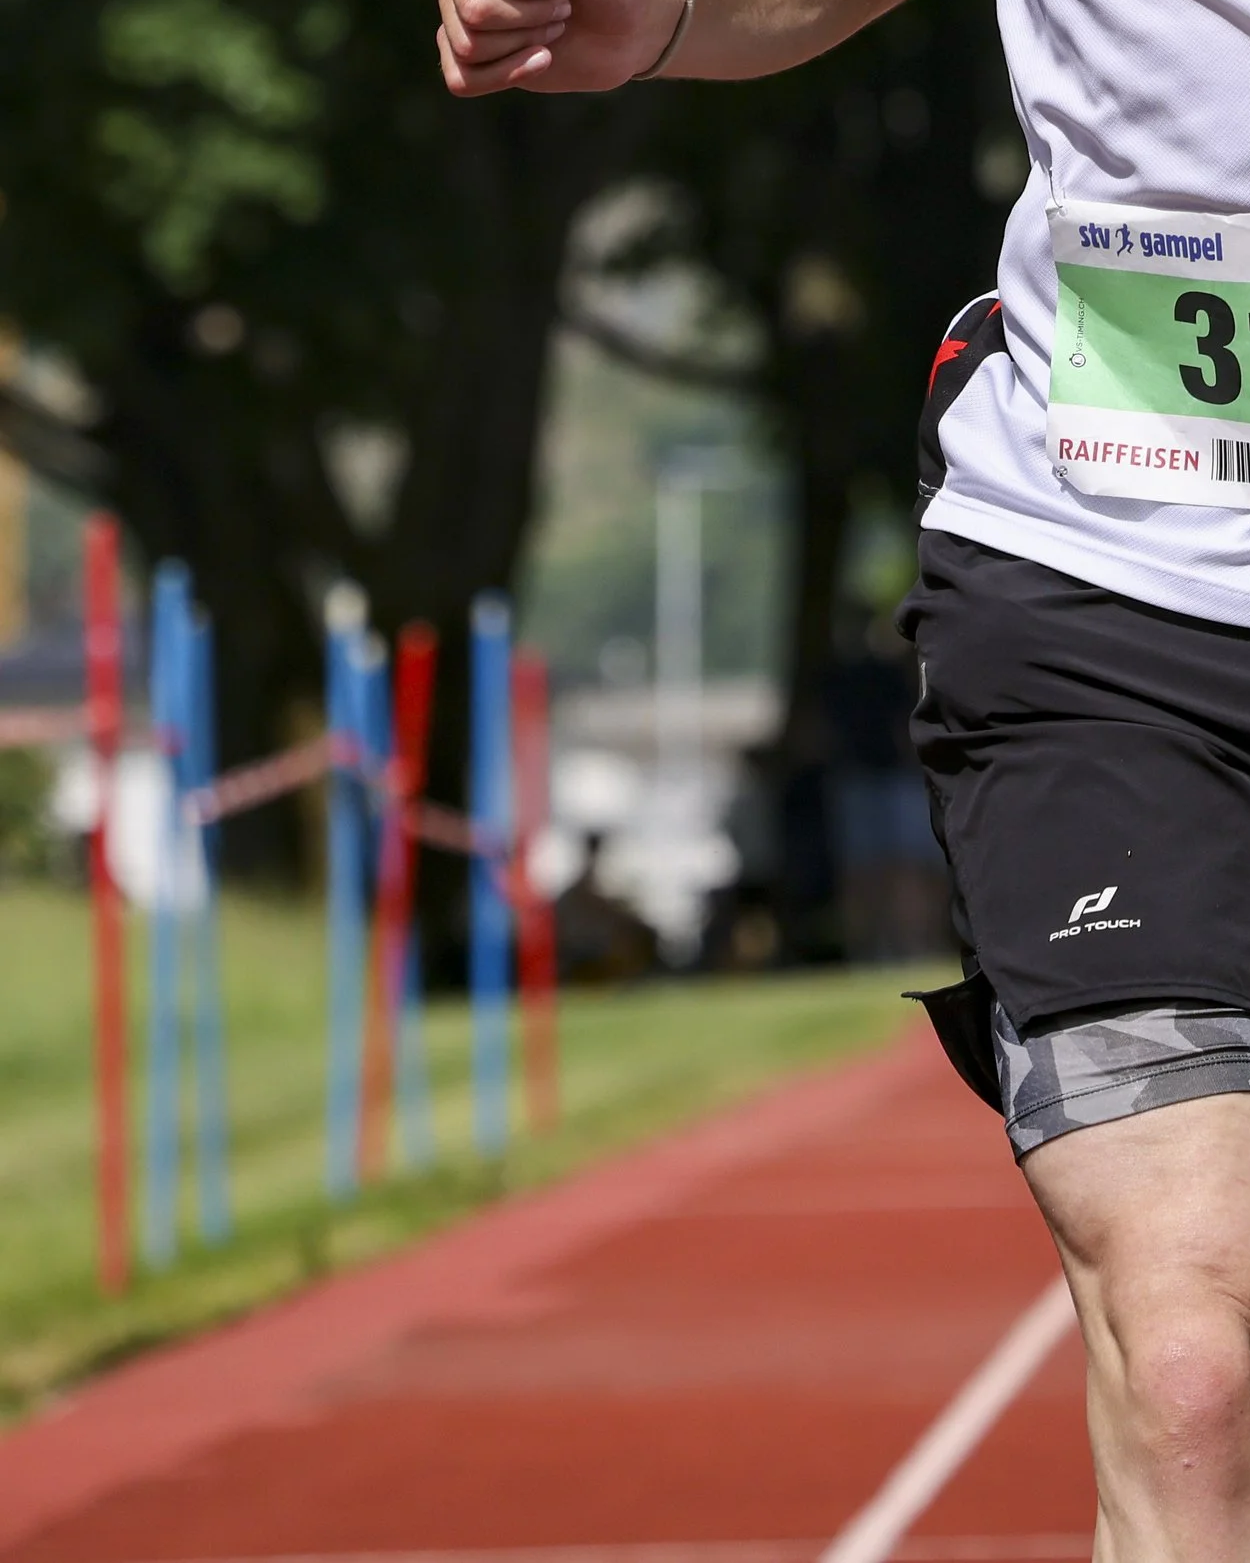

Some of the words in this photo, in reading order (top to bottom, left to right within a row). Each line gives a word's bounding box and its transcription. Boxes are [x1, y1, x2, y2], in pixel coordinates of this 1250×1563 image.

[1078, 222, 1110, 250] stv
[1140, 231, 1225, 263] gampel
[1058, 438, 1200, 472] RAIFFEISEN
[1048, 925, 1083, 942] PRO
[1084, 918, 1142, 933] TOUCH
